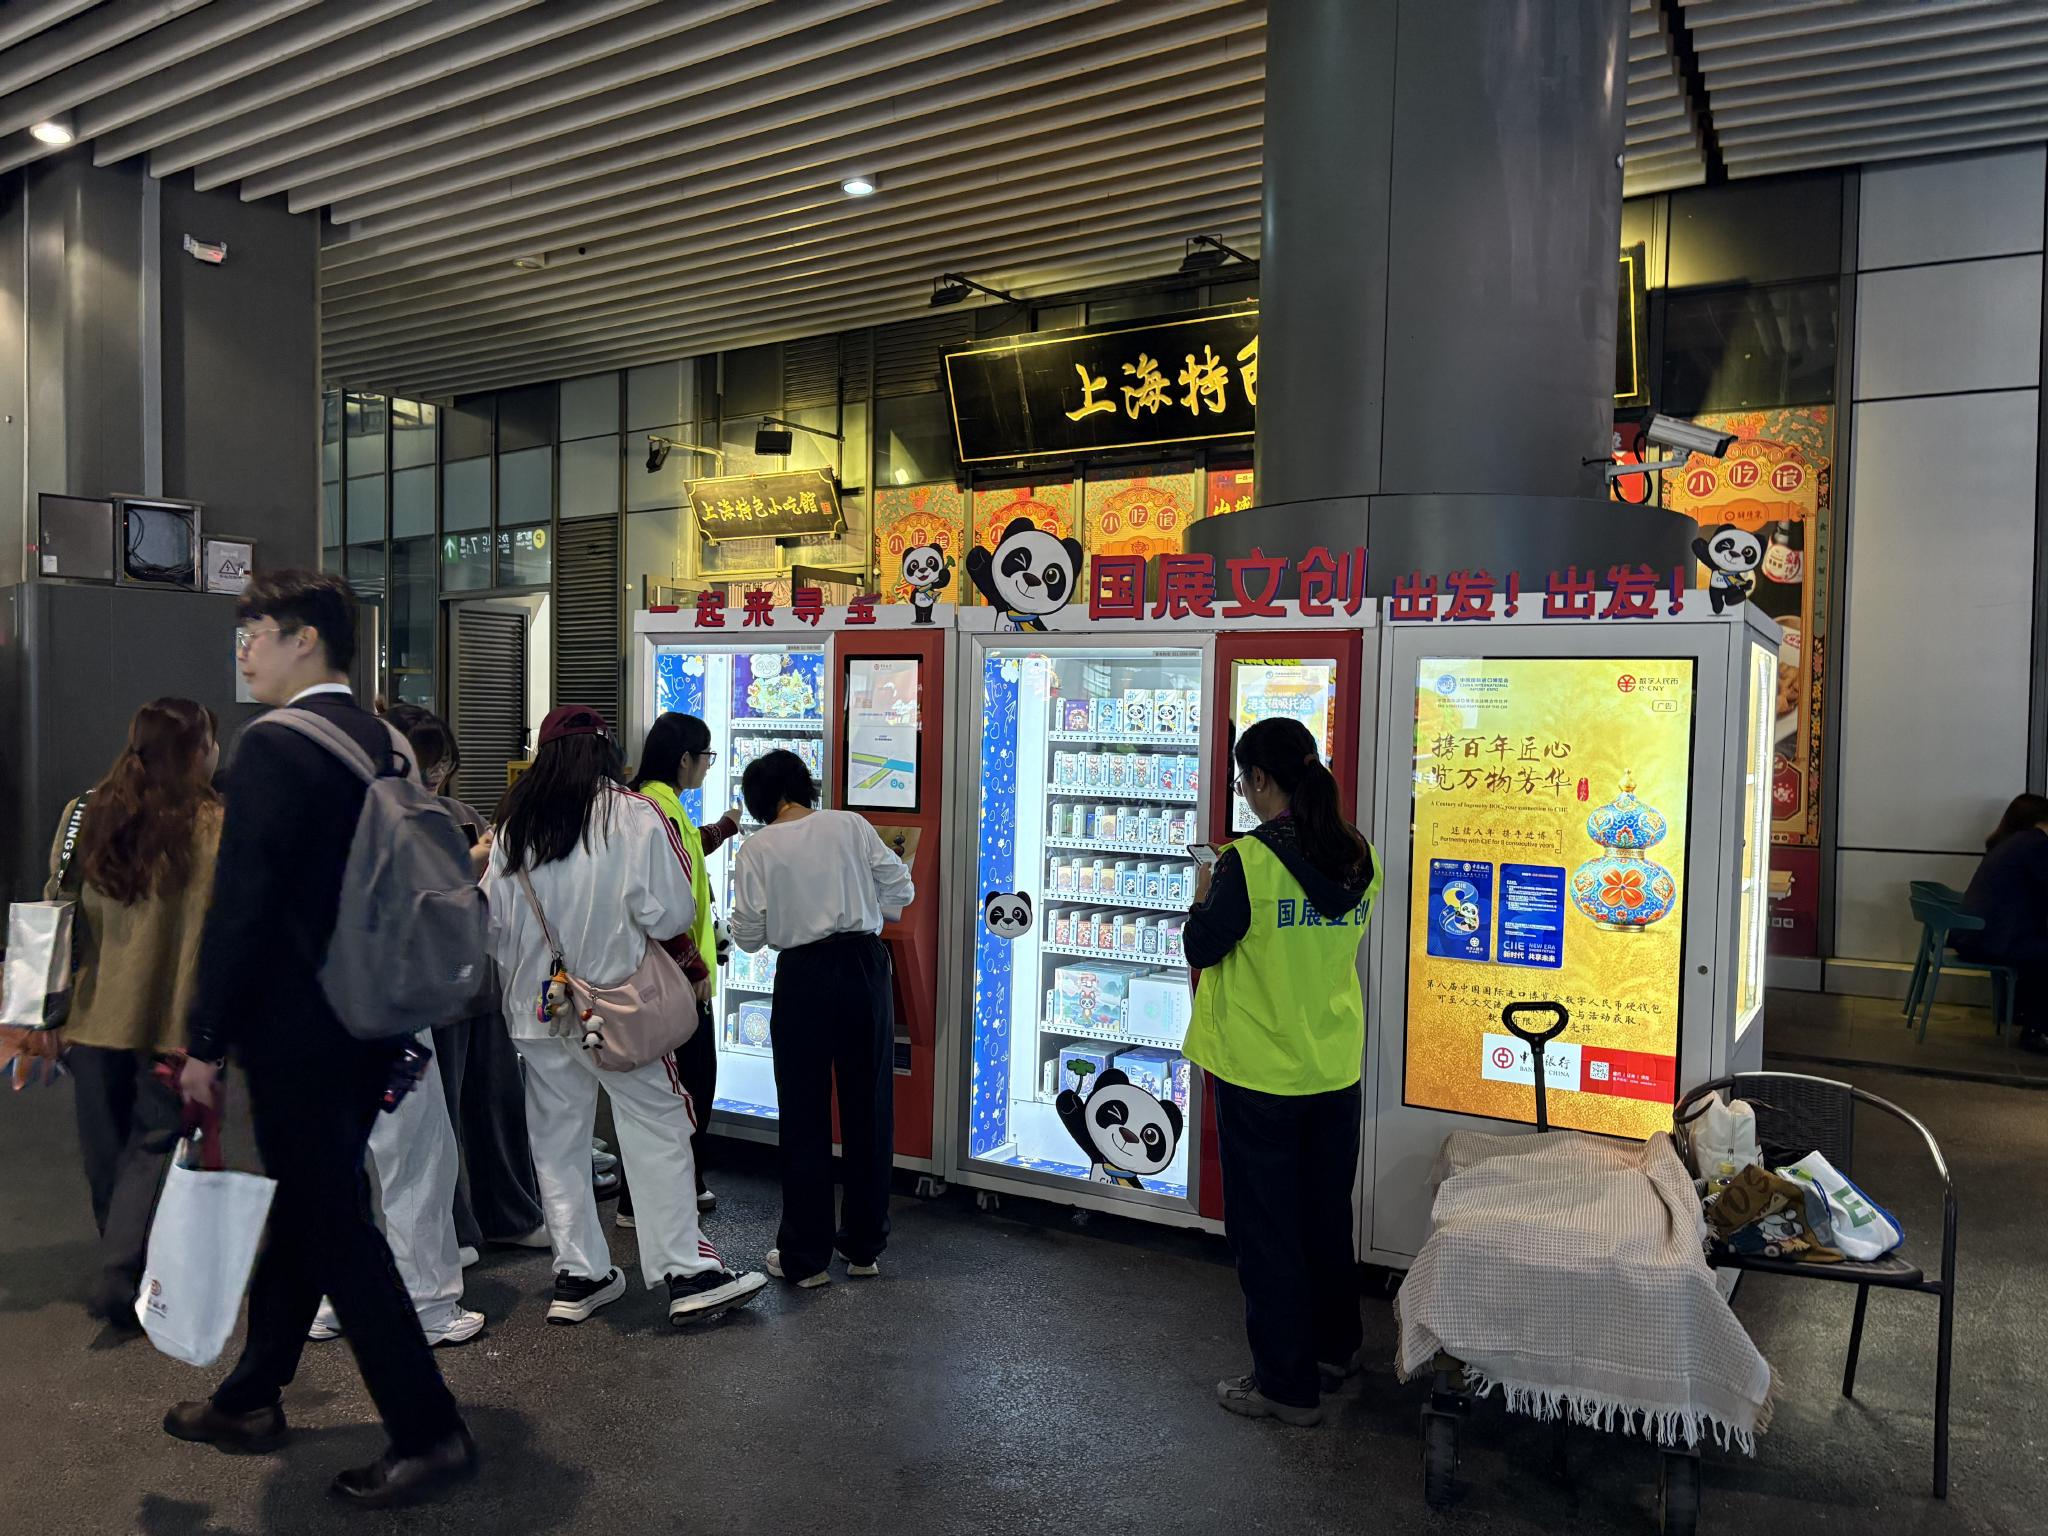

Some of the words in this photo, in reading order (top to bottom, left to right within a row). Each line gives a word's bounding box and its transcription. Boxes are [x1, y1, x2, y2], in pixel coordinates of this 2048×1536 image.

[1689, 464, 1798, 493] 小吃馆
[1103, 509, 1175, 531] 小吃馆
[1089, 547, 1368, 620] 国展文创
[1431, 733, 1571, 762] 携百年匠心
[1429, 764, 1572, 797] 览万物芳华
[1503, 941, 1525, 951] CIIE
[1520, 1051, 1571, 1069] 中银行
[1548, 1070, 1570, 1078] CHINA
